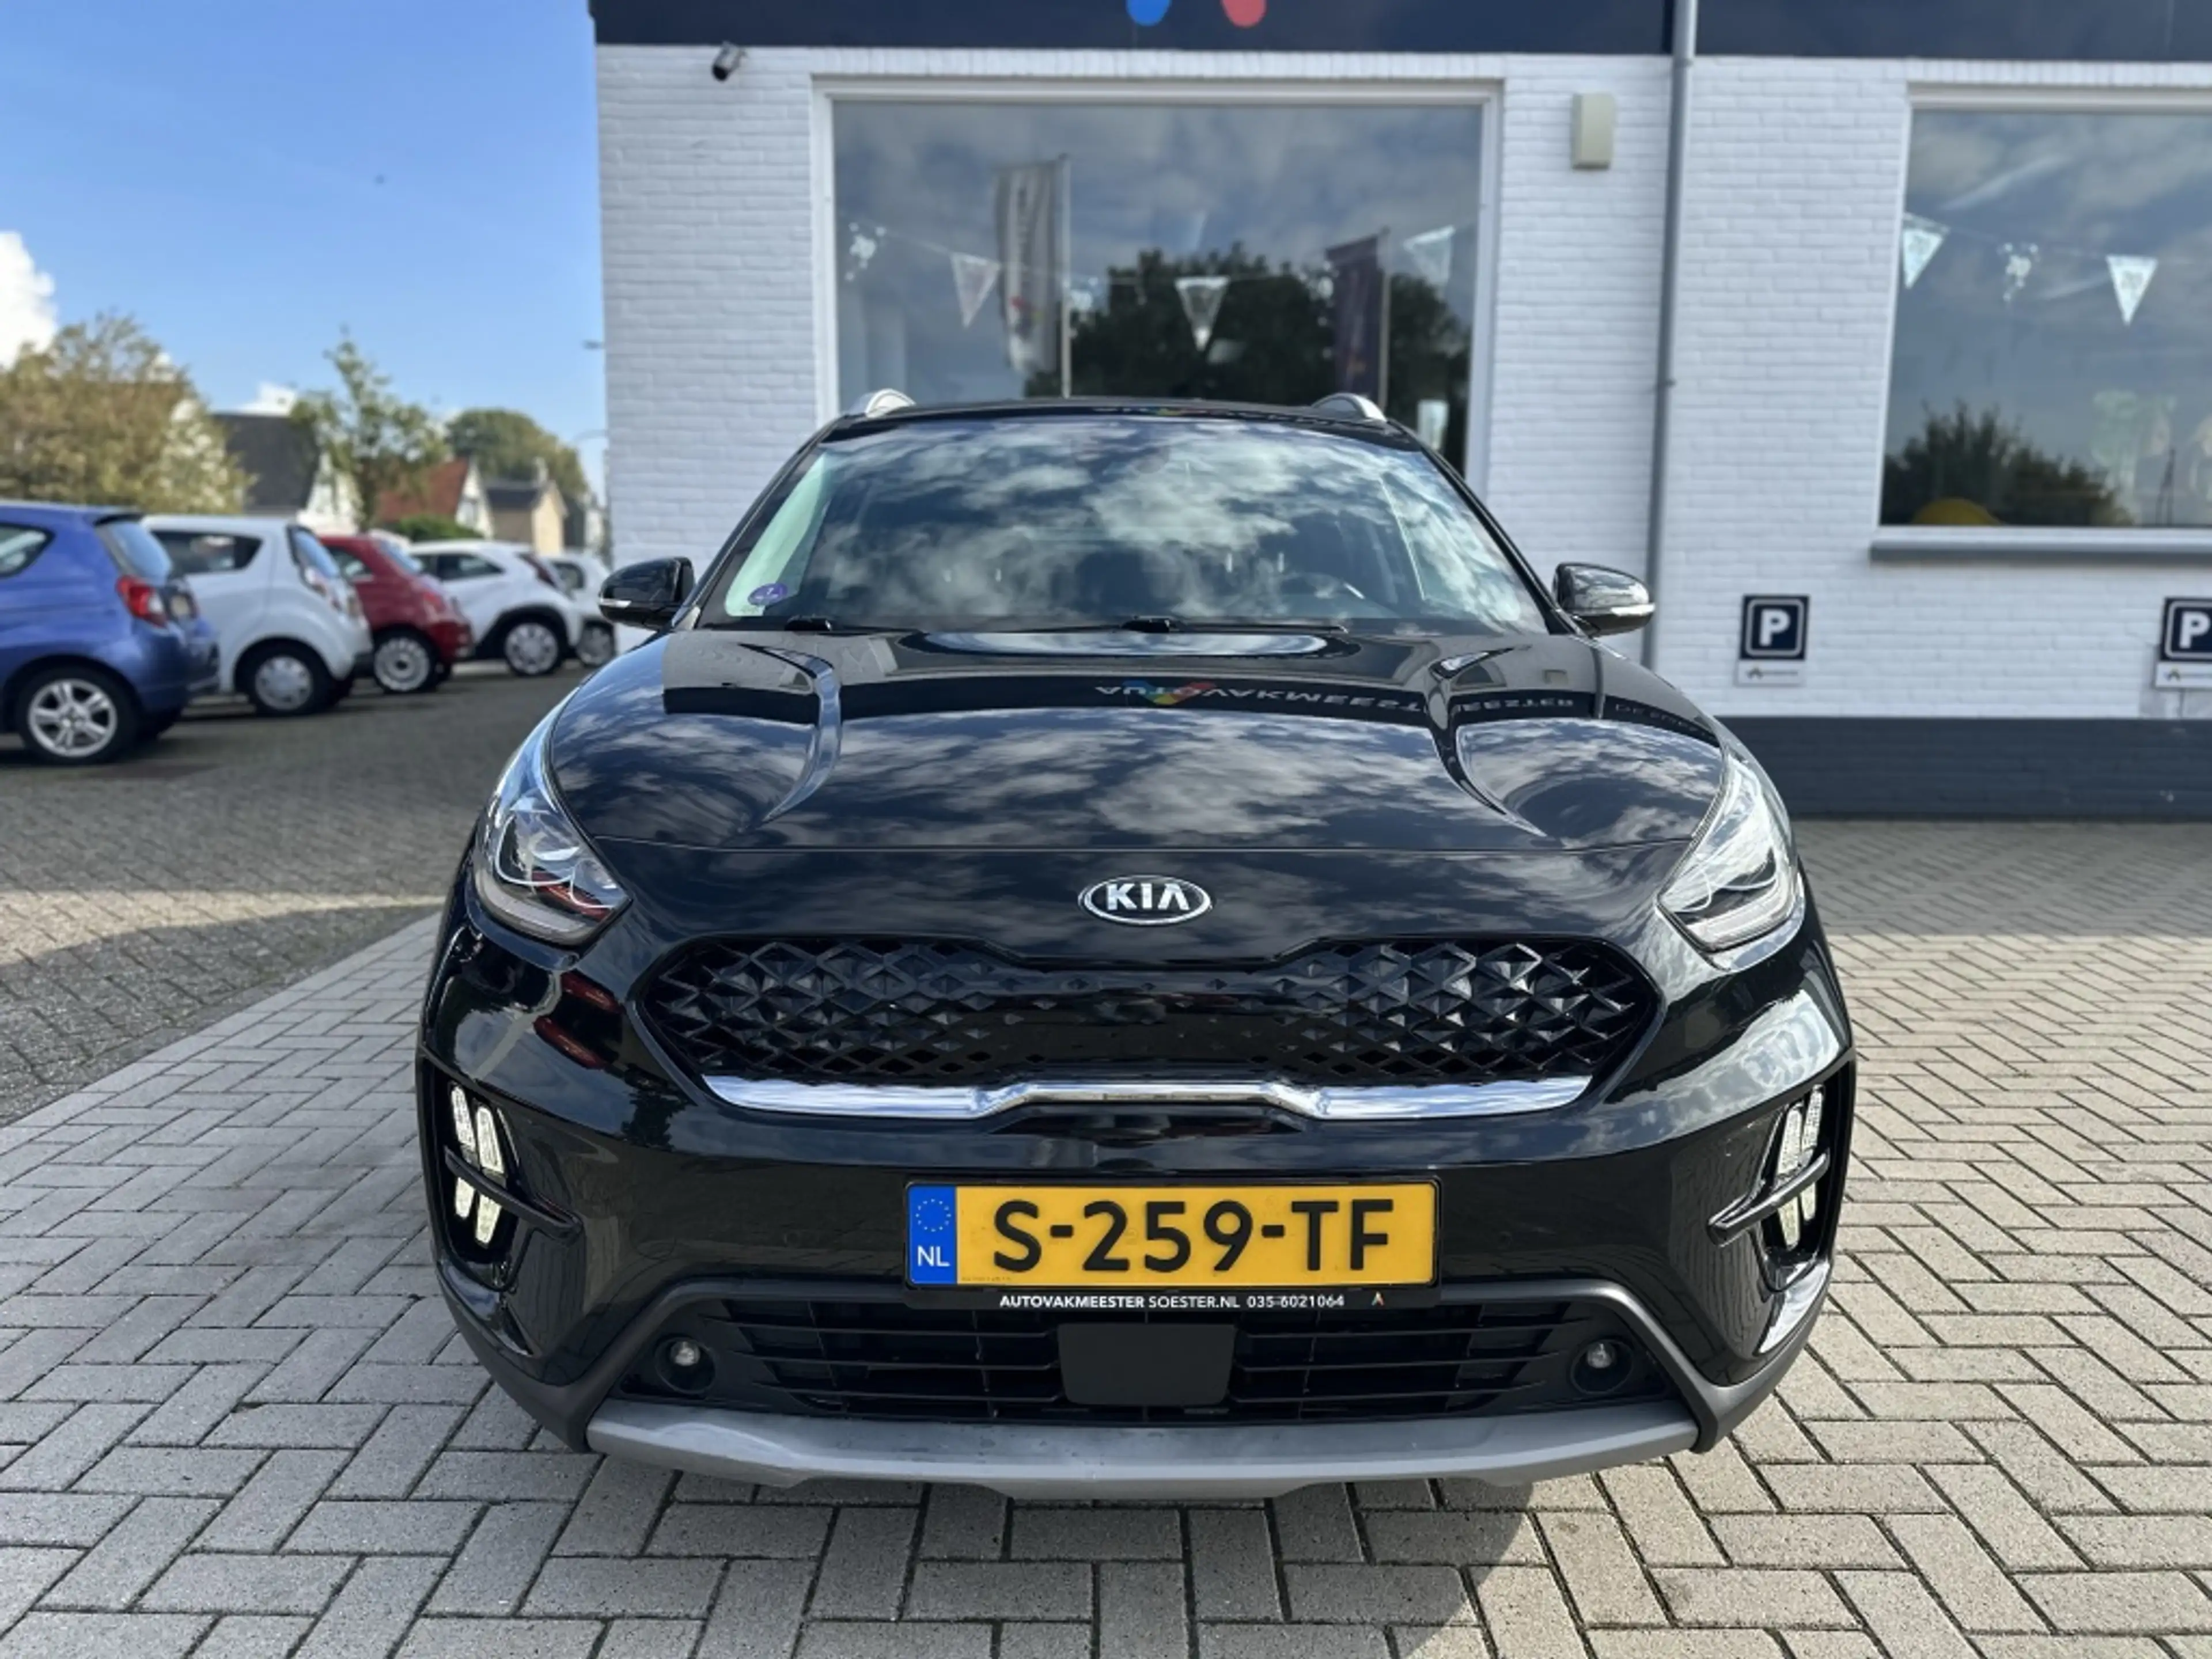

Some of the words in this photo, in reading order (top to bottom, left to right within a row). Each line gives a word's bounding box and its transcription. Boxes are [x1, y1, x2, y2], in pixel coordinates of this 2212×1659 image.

[1759, 608, 1790, 646] P
[2179, 611, 2211, 649] P
[1107, 882, 1190, 910] KIA
[918, 1245, 950, 1267] NL
[993, 1199, 1394, 1273] S-259-TF
[999, 1296, 1145, 1308] AUTOVAKMEESTER
[1148, 1296, 1241, 1308] SOESTER.NL
[1247, 1296, 1345, 1308] 035-6021064
